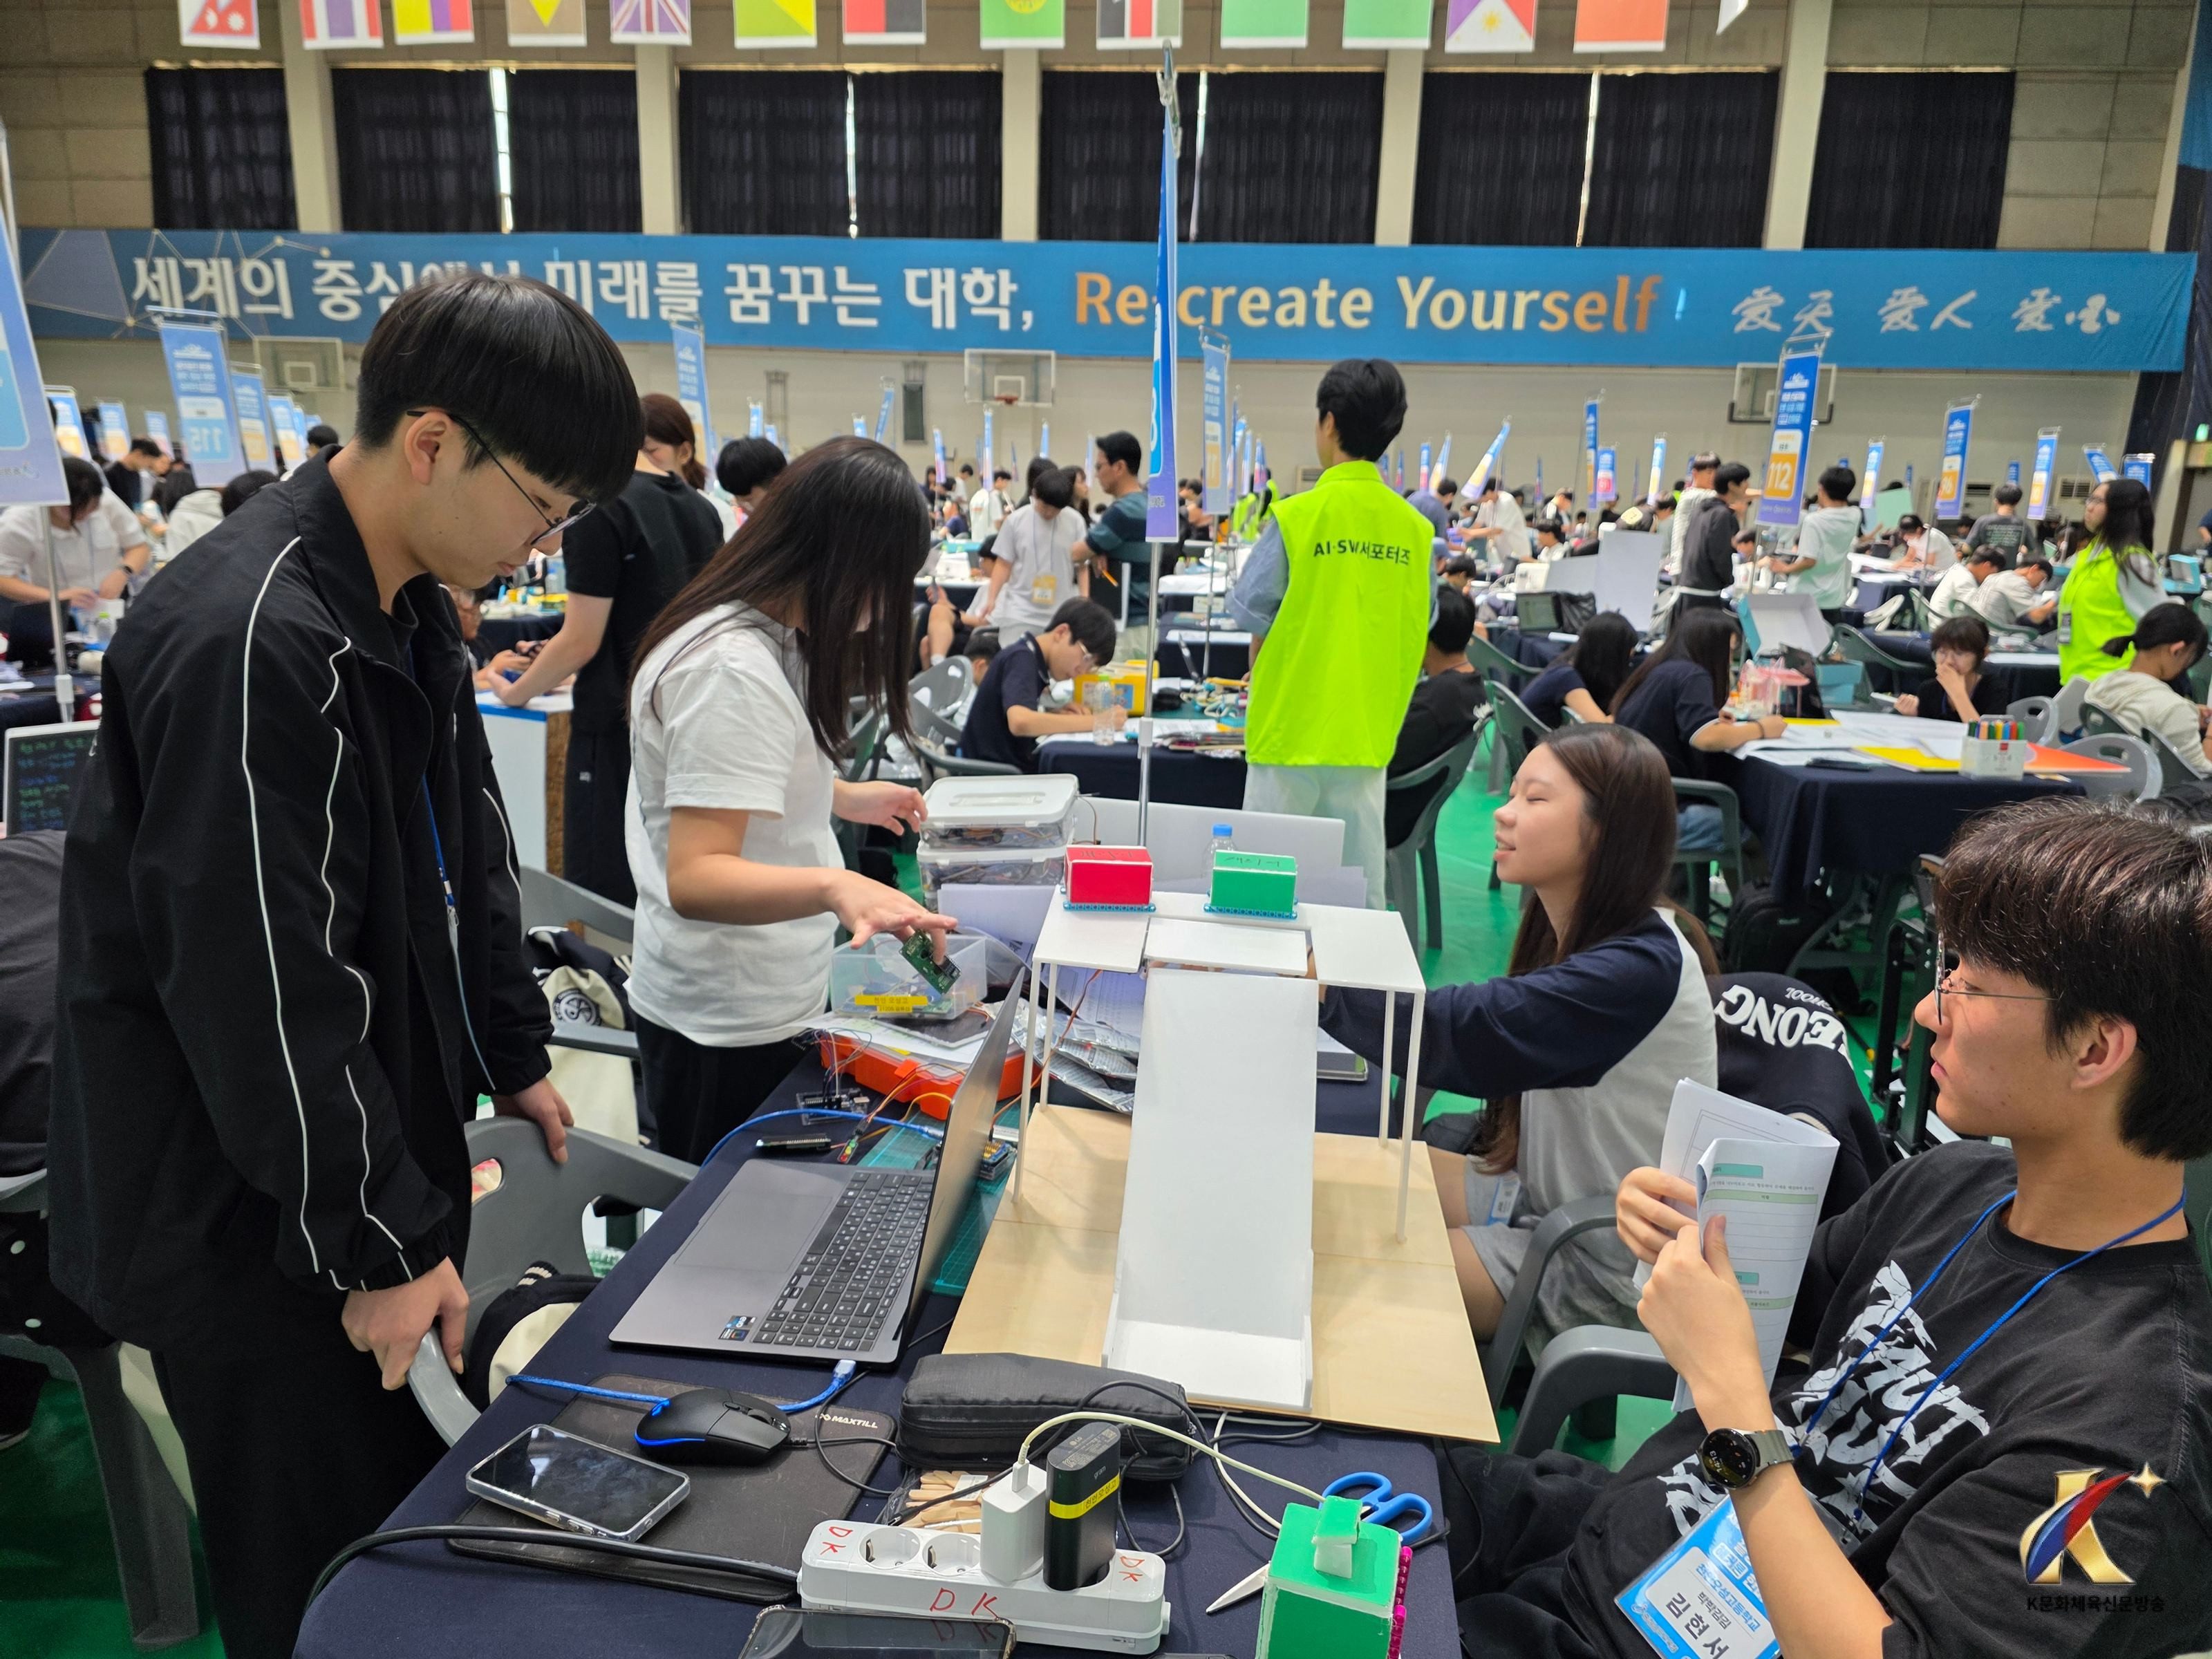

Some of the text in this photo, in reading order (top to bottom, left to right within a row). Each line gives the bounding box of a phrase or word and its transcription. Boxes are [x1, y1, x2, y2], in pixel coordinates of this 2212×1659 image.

[133, 257, 294, 319] 세계의
[543, 259, 703, 320] 미래를
[724, 263, 882, 327] 꿈꾸는
[903, 267, 1033, 332] 대학,
[1396, 274, 1662, 332] Yourself
[1768, 461, 1792, 490] 112
[1714, 984, 1850, 1056] EONG
[832, 1415, 878, 1429] MAXTILL
[1094, 1465, 1107, 1480] gram
[1709, 1450, 1723, 1473] 14:13
[821, 1526, 853, 1555] DK
[1118, 1556, 1145, 1582] DK
